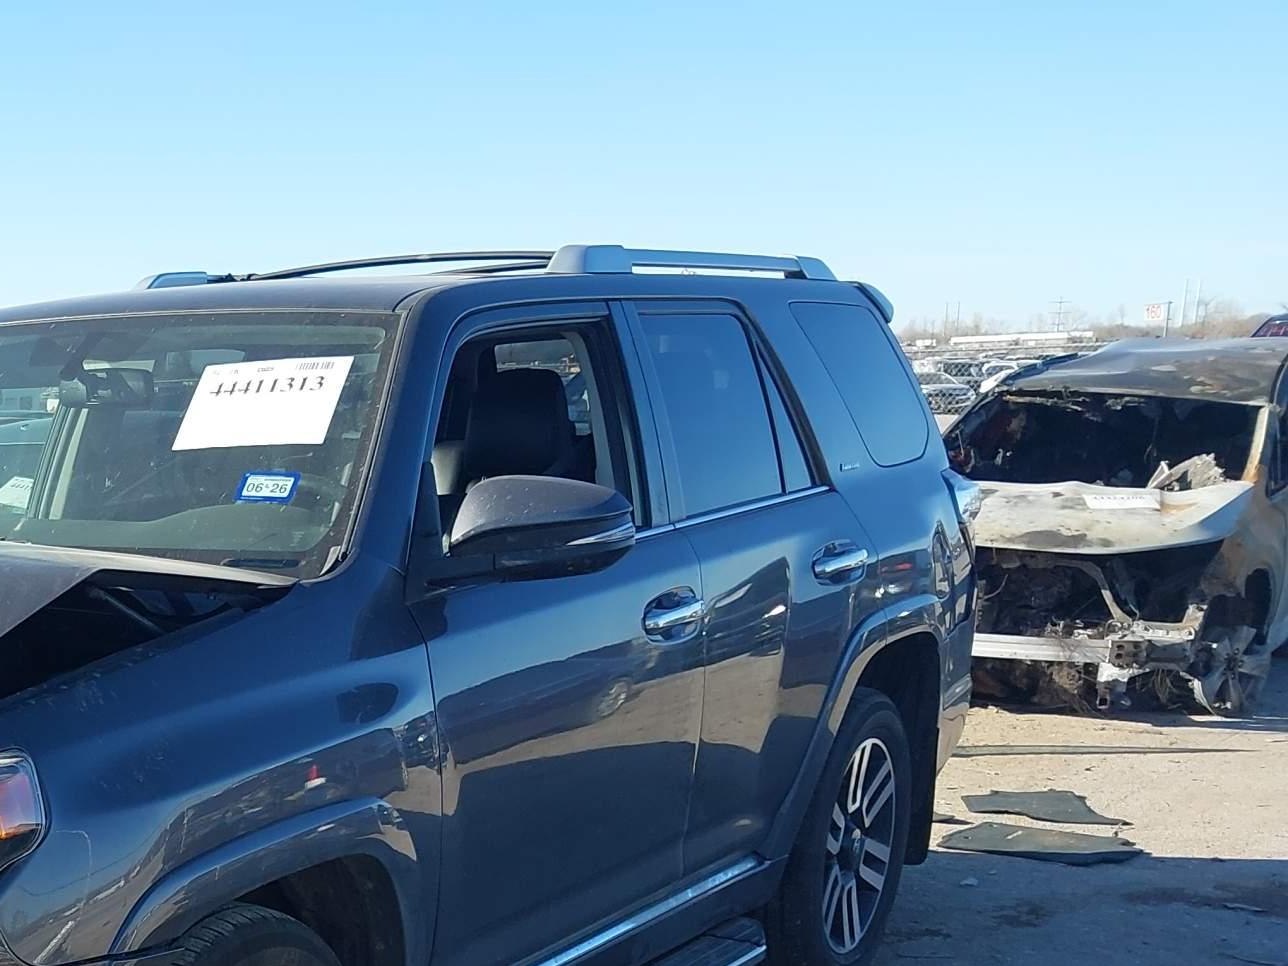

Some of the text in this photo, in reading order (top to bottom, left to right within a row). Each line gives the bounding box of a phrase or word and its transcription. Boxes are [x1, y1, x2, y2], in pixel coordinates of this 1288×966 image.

[210, 375, 325, 397] 44411313
[246, 482, 288, 494] 06 26
